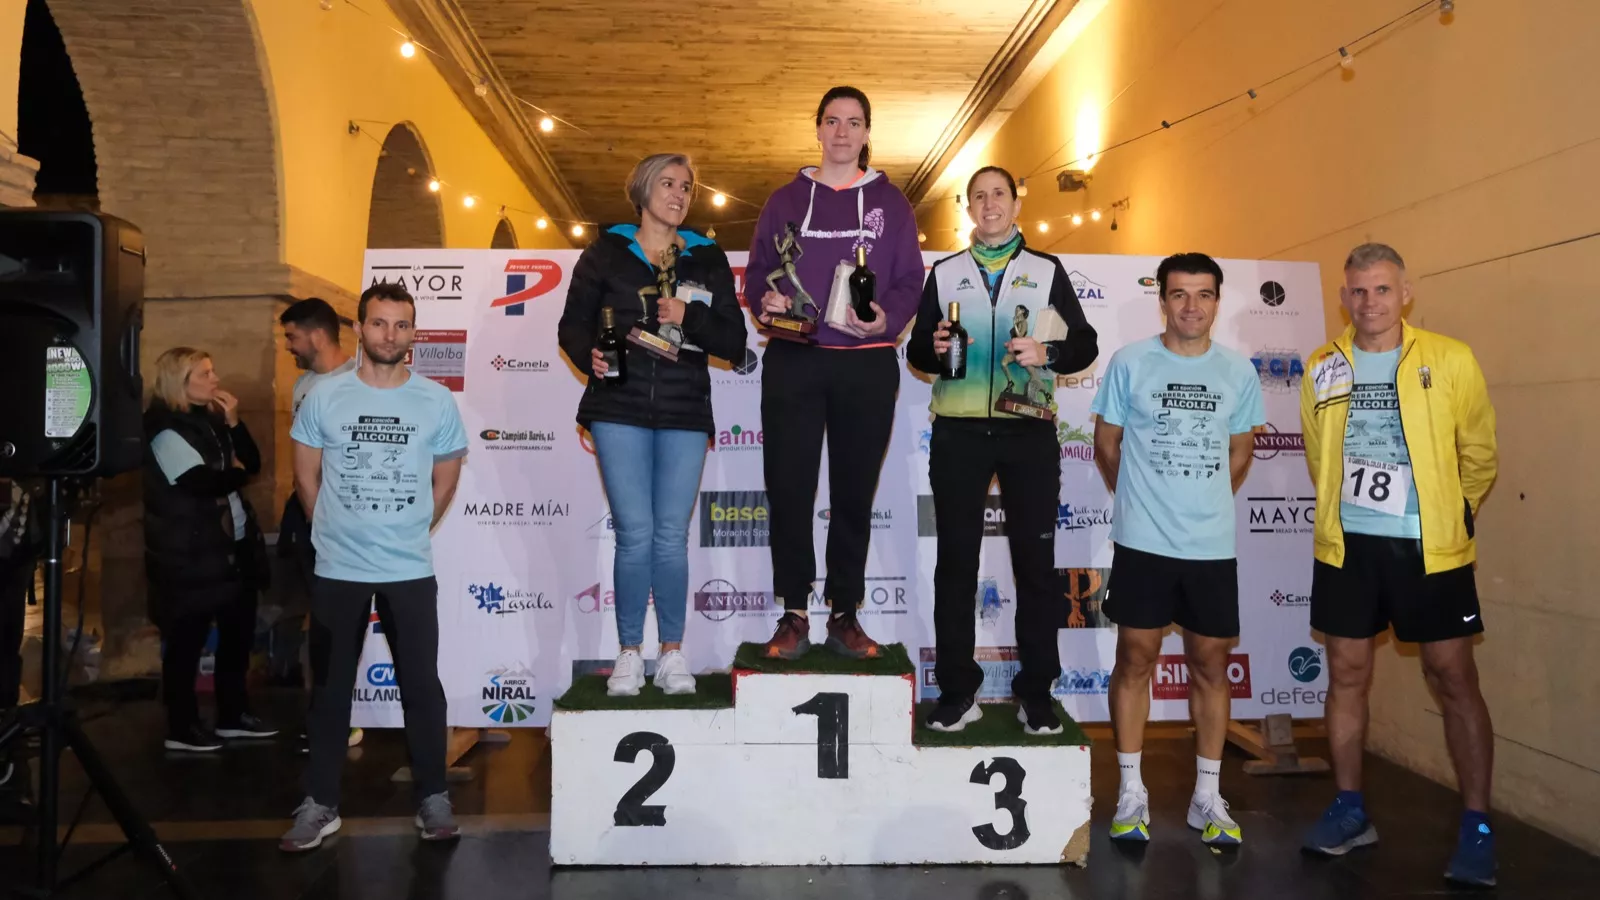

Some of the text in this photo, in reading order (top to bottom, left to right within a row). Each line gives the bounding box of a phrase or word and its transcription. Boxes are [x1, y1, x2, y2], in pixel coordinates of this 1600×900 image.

[370, 275, 463, 292] MAYOR
[50, 347, 72, 358] NEW
[419, 346, 463, 360] Villalba
[507, 359, 550, 369] Canela
[1188, 392, 1222, 400] POPULAR
[1166, 399, 1214, 410] ALCOLEA
[1350, 400, 1399, 409] ALCOLEA
[355, 433, 406, 443] ALCOLEA
[1350, 467, 1392, 502] 18
[464, 498, 569, 516] MADRE MÍA!
[710, 502, 769, 521] base
[713, 528, 749, 538] Moracho
[705, 595, 768, 607] ANTONIO
[482, 686, 536, 701] NIRAL
[792, 691, 849, 779] 1
[613, 731, 676, 827] 2
[969, 756, 1031, 850] 3
